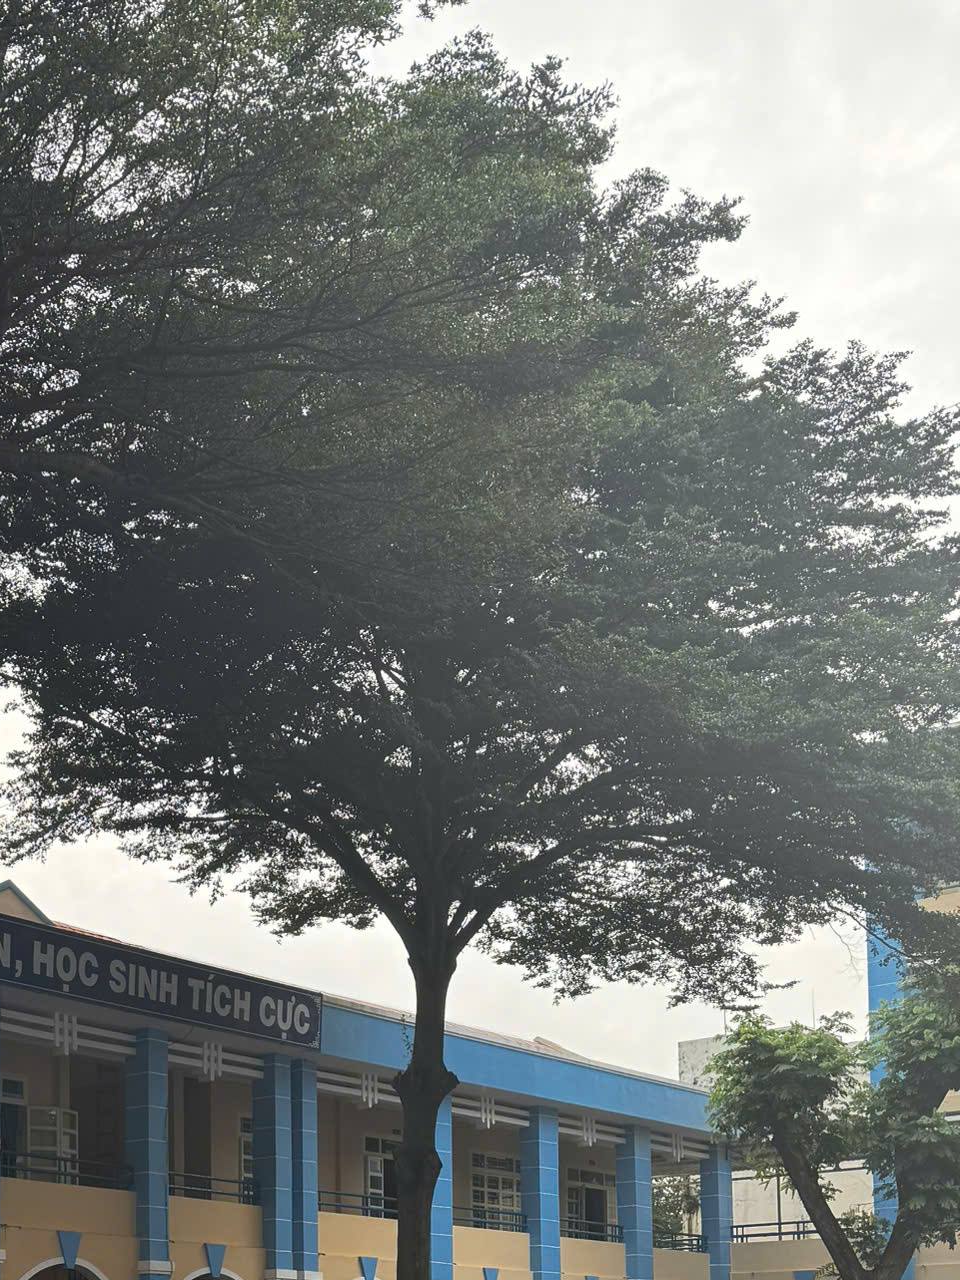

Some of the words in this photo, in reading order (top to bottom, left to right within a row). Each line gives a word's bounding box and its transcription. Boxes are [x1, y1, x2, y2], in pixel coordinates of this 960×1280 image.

[33, 941, 99, 991] HỌC
[108, 959, 179, 1006] SINH
[188, 974, 251, 1021] TÍCH
[259, 995, 311, 1040] CỰC
